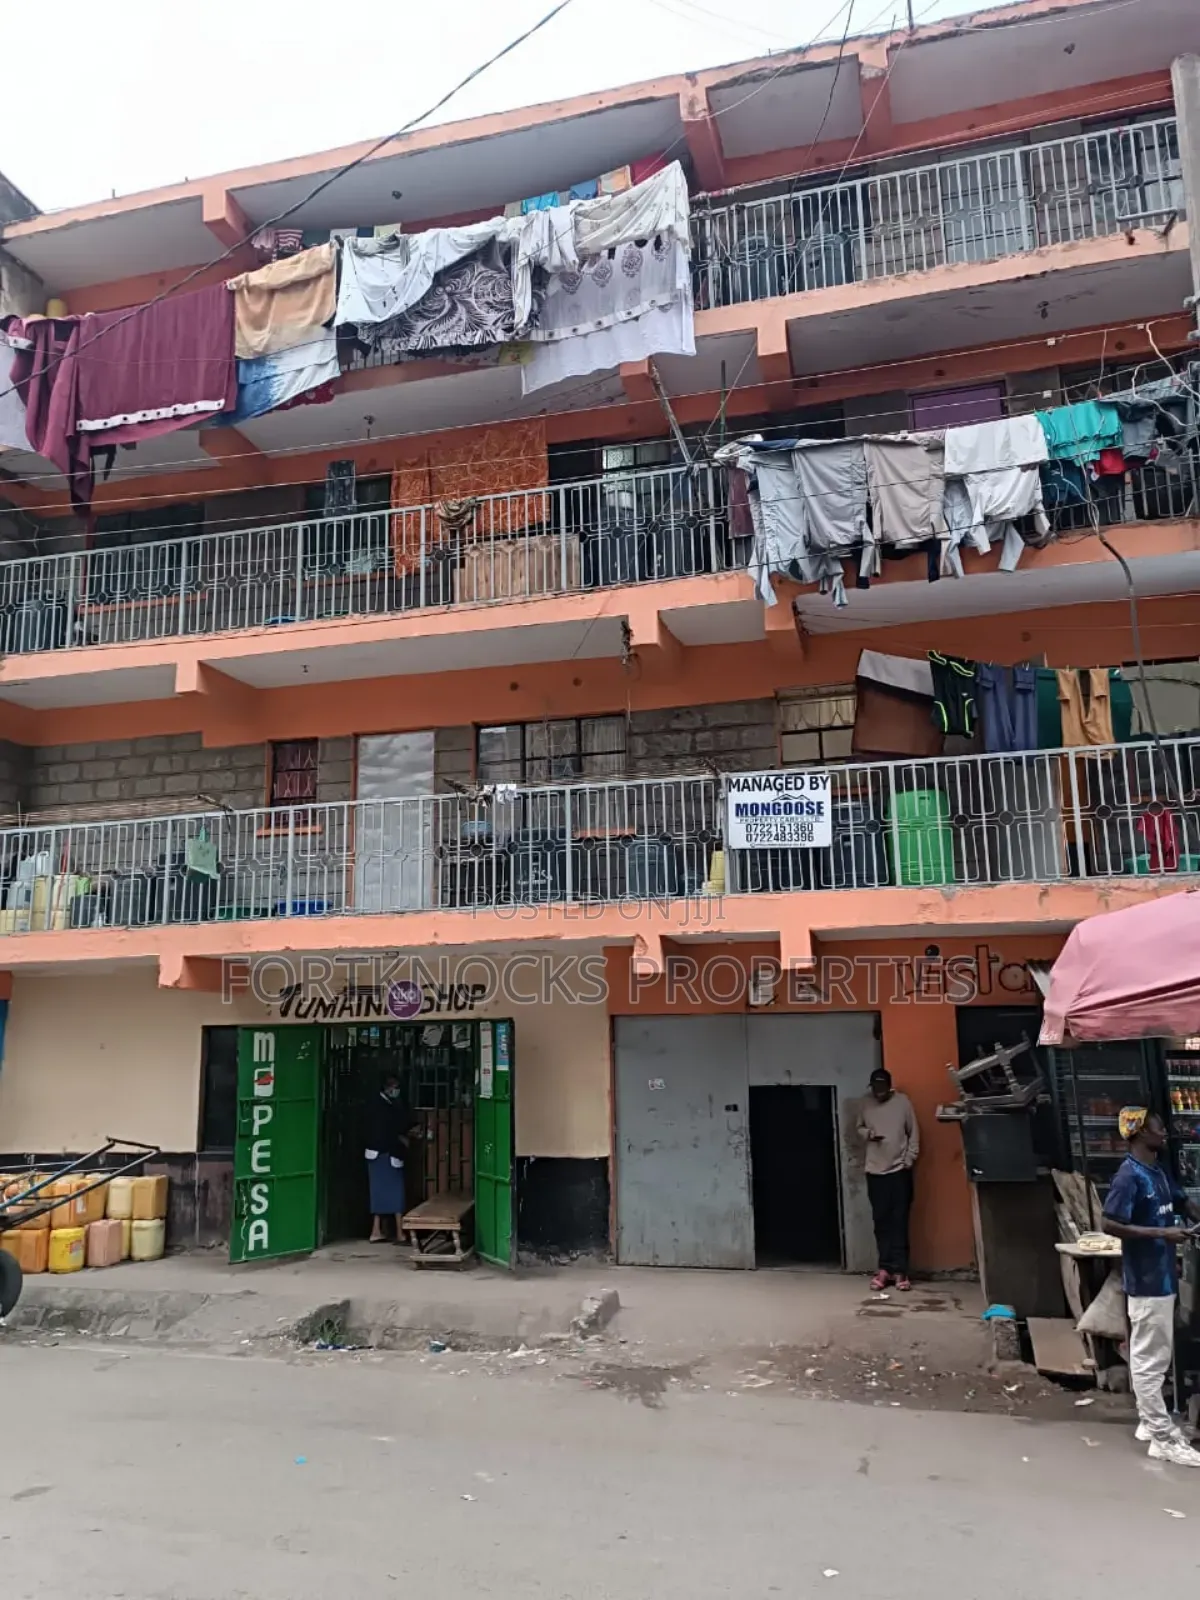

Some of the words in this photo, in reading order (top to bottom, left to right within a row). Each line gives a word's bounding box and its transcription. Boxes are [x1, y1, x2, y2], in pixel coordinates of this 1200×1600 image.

[728, 776, 805, 792] MANAGED
[809, 776, 830, 791] BY
[735, 801, 825, 818] MONGOOSE
[745, 823, 814, 833] 0722151360
[745, 832, 815, 842] 0722483396
[419, 983, 487, 1014] SHOP
